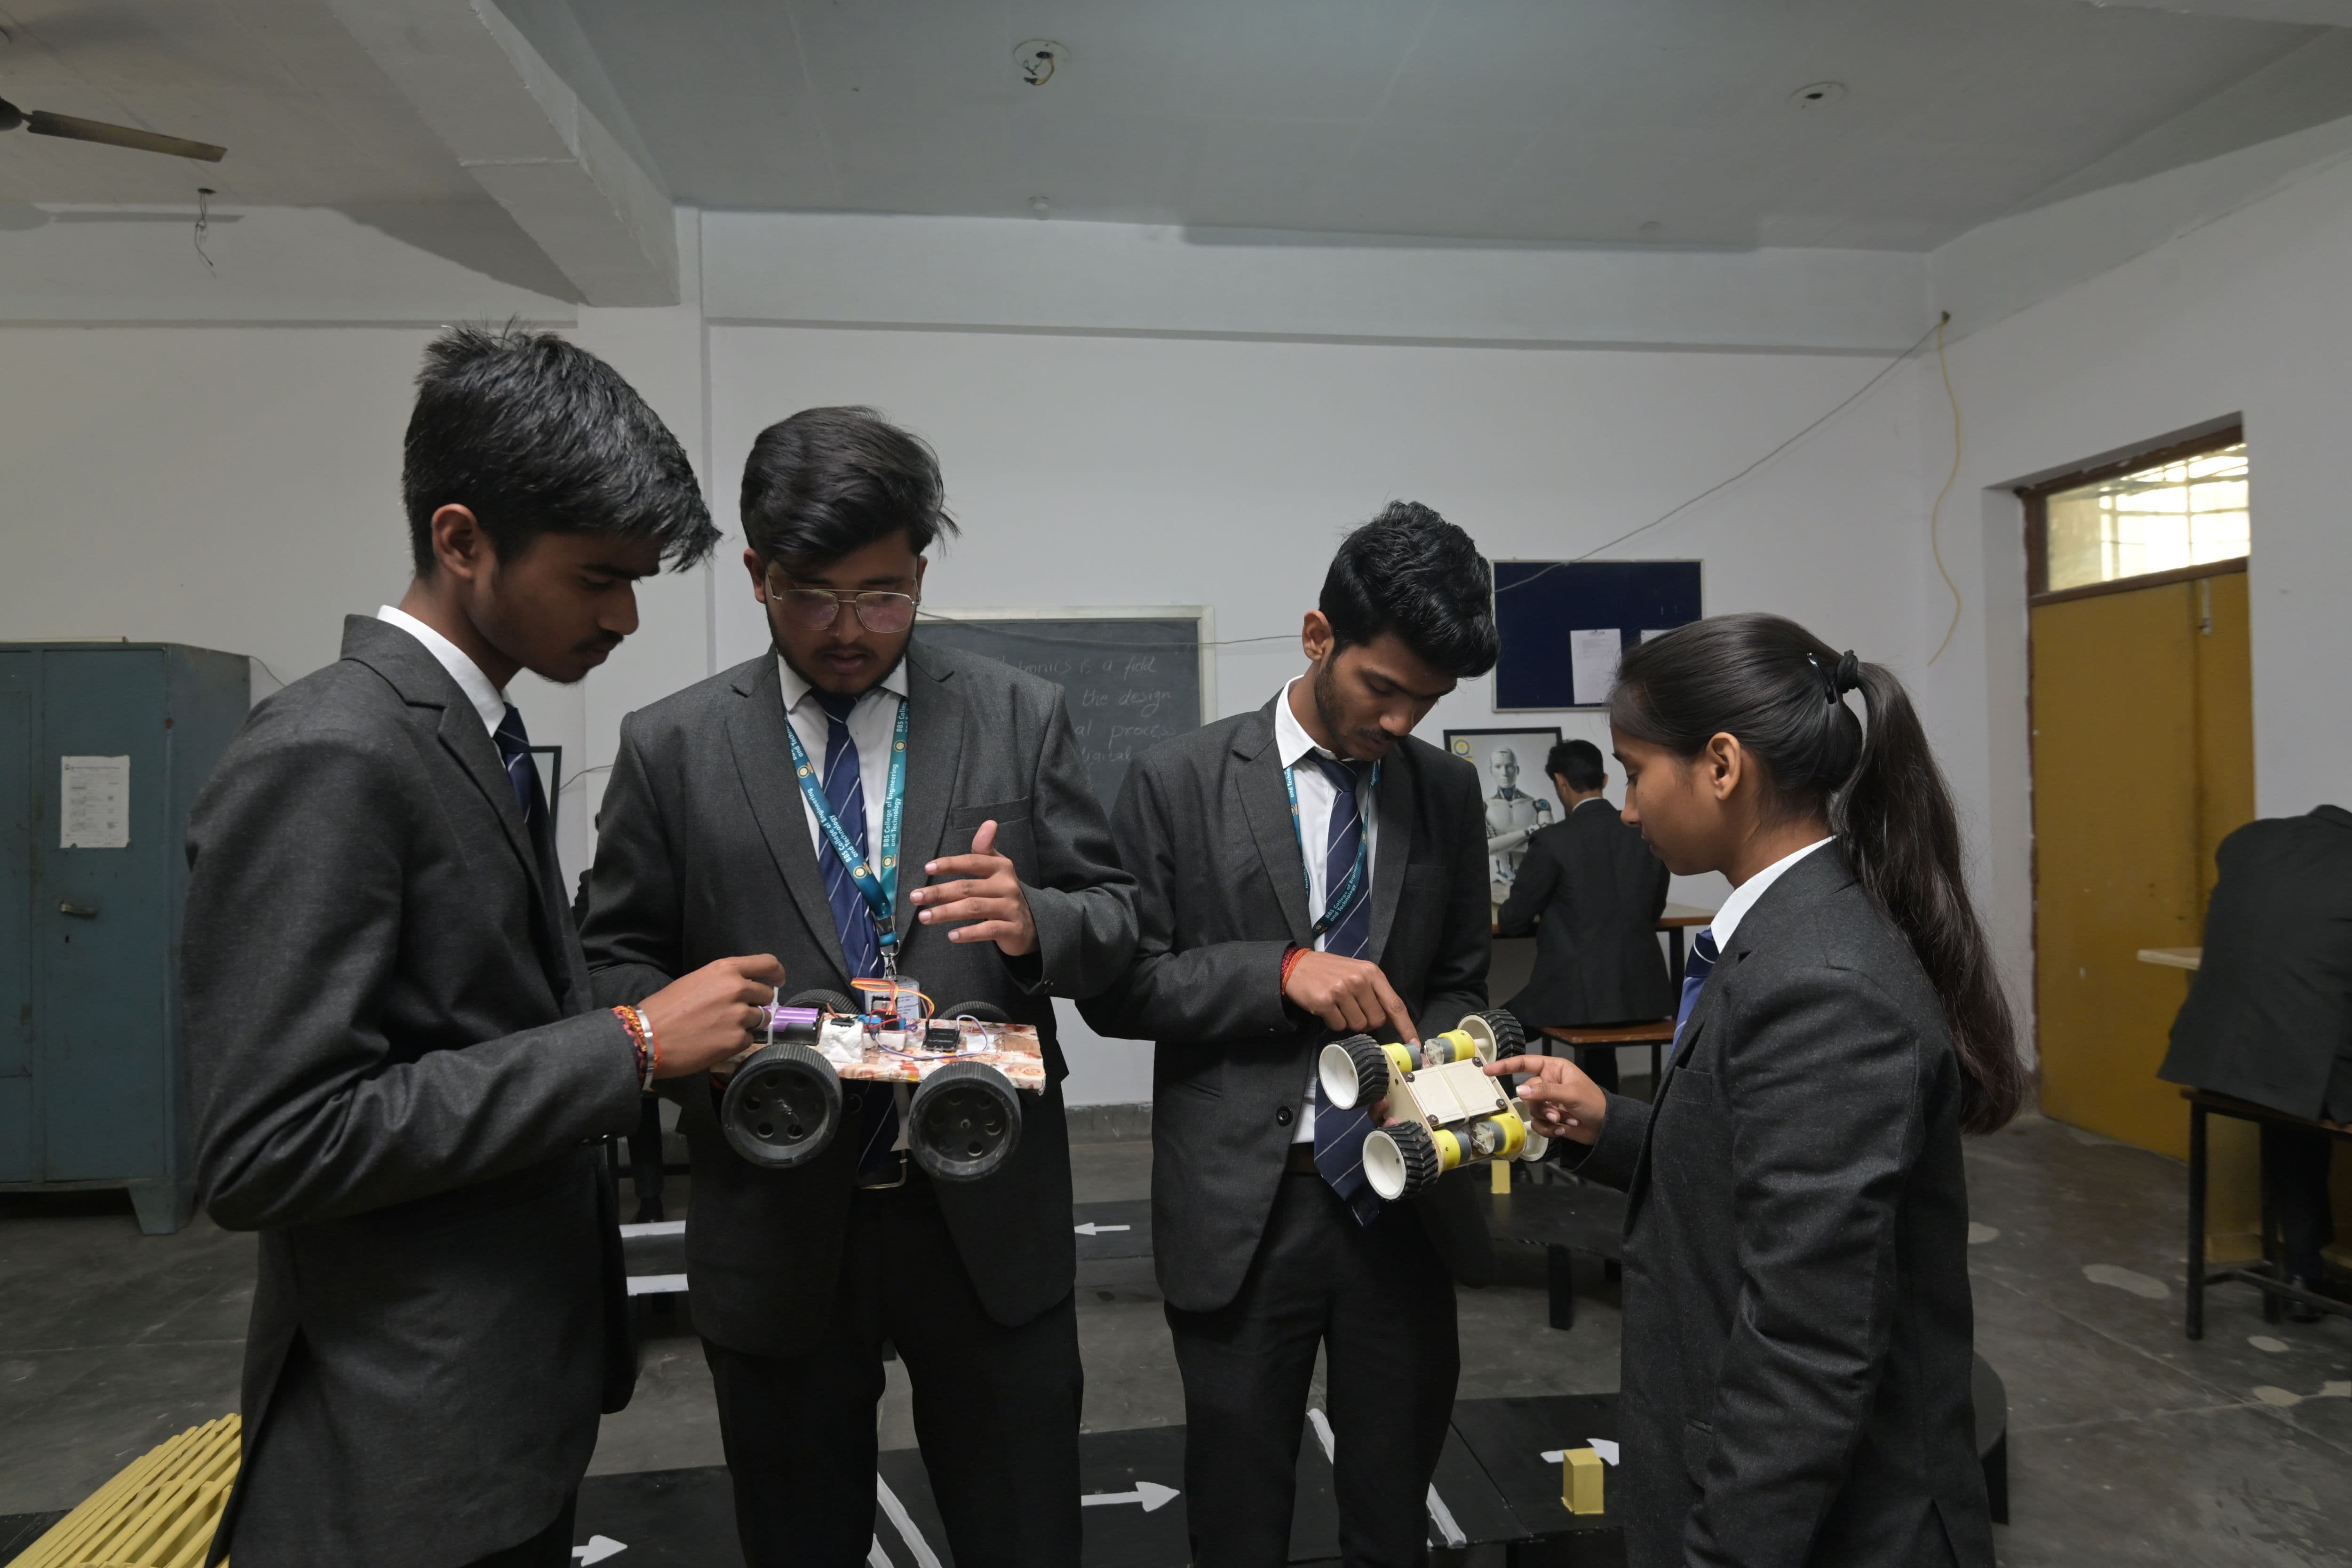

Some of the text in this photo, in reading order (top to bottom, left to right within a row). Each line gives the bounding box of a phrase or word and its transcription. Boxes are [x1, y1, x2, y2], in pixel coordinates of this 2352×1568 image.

[1081, 660, 1091, 674] is
[1102, 660, 1112, 672] a
[1124, 656, 1156, 680] field
[1083, 688, 1171, 717] the design
[794, 746, 804, 757] and
[887, 764, 899, 800] Engineering
[807, 788, 826, 823] Engineering
[891, 797, 902, 832] Technology
[828, 814, 858, 858] and Technology
[829, 829, 845, 851] College
[842, 851, 852, 863] BBS
[1325, 909, 1335, 919] BBS
[1334, 891, 1348, 909] College
[1349, 852, 1362, 884] Engineering
[1330, 883, 1356, 922] and Technology
